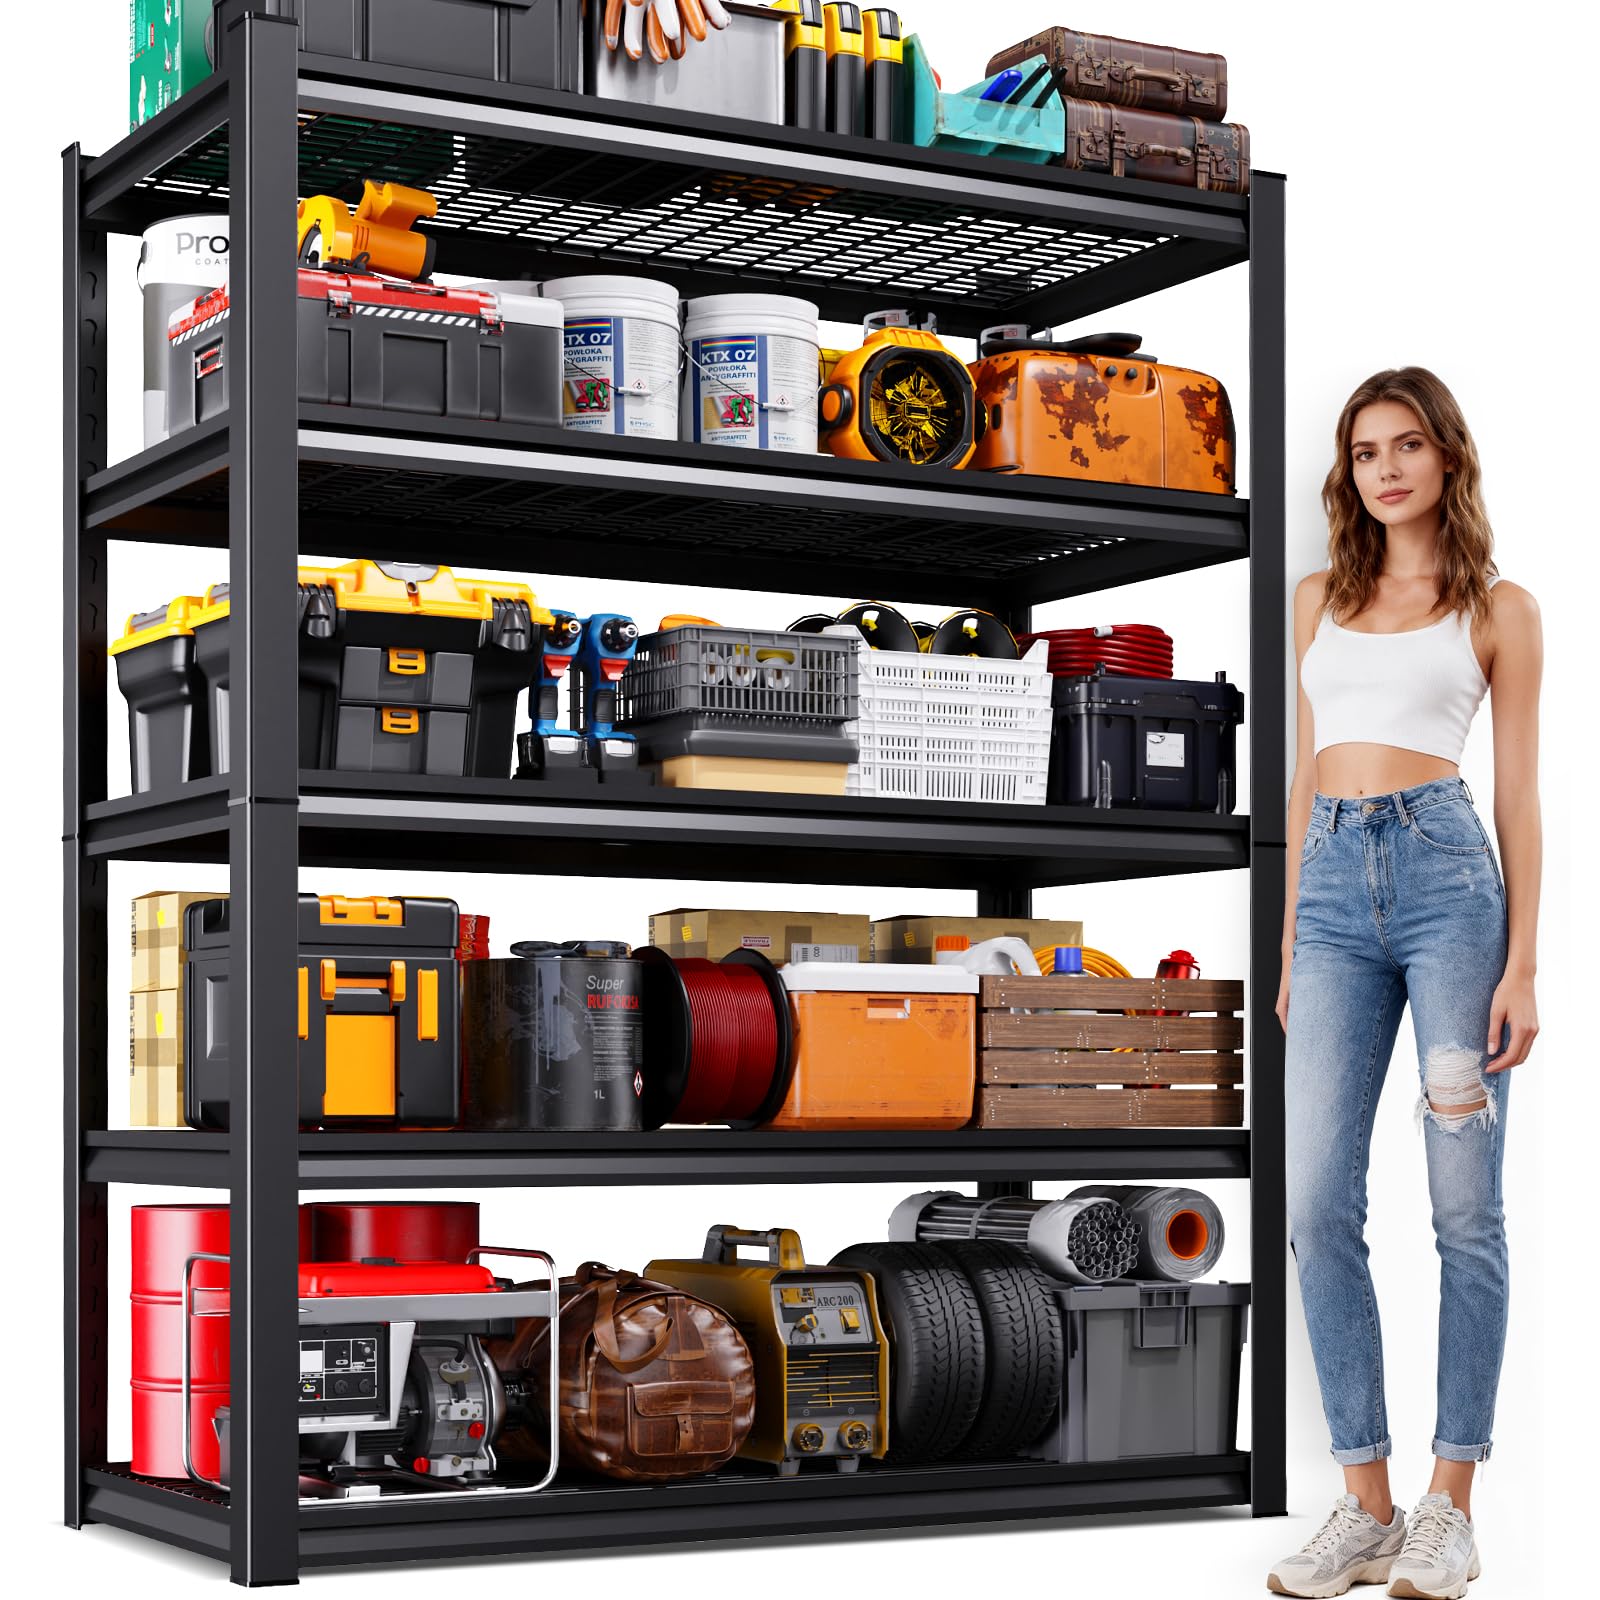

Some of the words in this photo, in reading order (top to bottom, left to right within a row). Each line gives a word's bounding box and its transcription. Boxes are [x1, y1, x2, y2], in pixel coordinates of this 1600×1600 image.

[176, 232, 230, 254] Pro
[564, 334, 586, 347] TX
[589, 333, 611, 345] 07
[701, 350, 730, 364] KTX
[734, 349, 756, 361] 07
[708, 364, 747, 373] POWŁOKA
[586, 975, 624, 992] Super
[593, 1088, 606, 1100] 1L
[817, 1296, 837, 1307] ARC
[838, 1295, 854, 1306] 200
